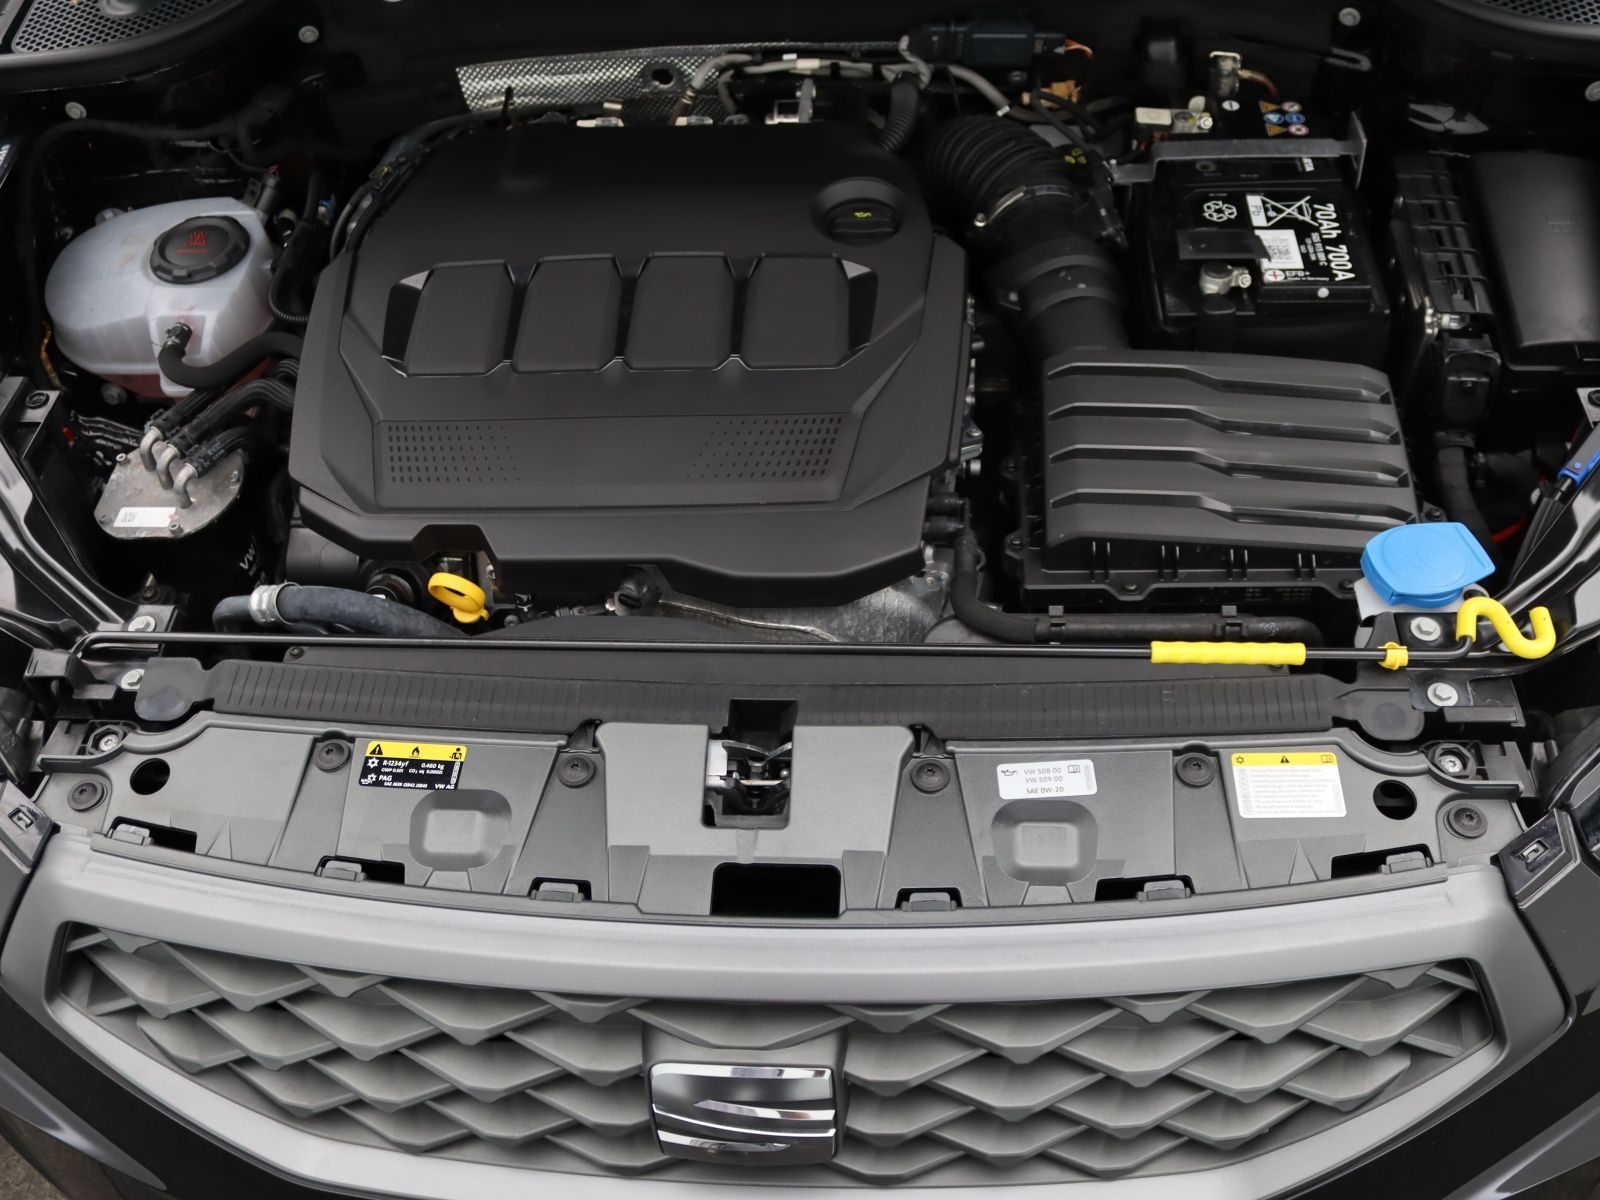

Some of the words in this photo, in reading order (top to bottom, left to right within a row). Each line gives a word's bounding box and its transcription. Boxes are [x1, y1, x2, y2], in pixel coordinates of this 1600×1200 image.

[1251, 204, 1262, 216] Pb
[1313, 203, 1342, 238] 70Ah
[1325, 244, 1356, 281] 700A
[382, 760, 410, 769] R-1234yf
